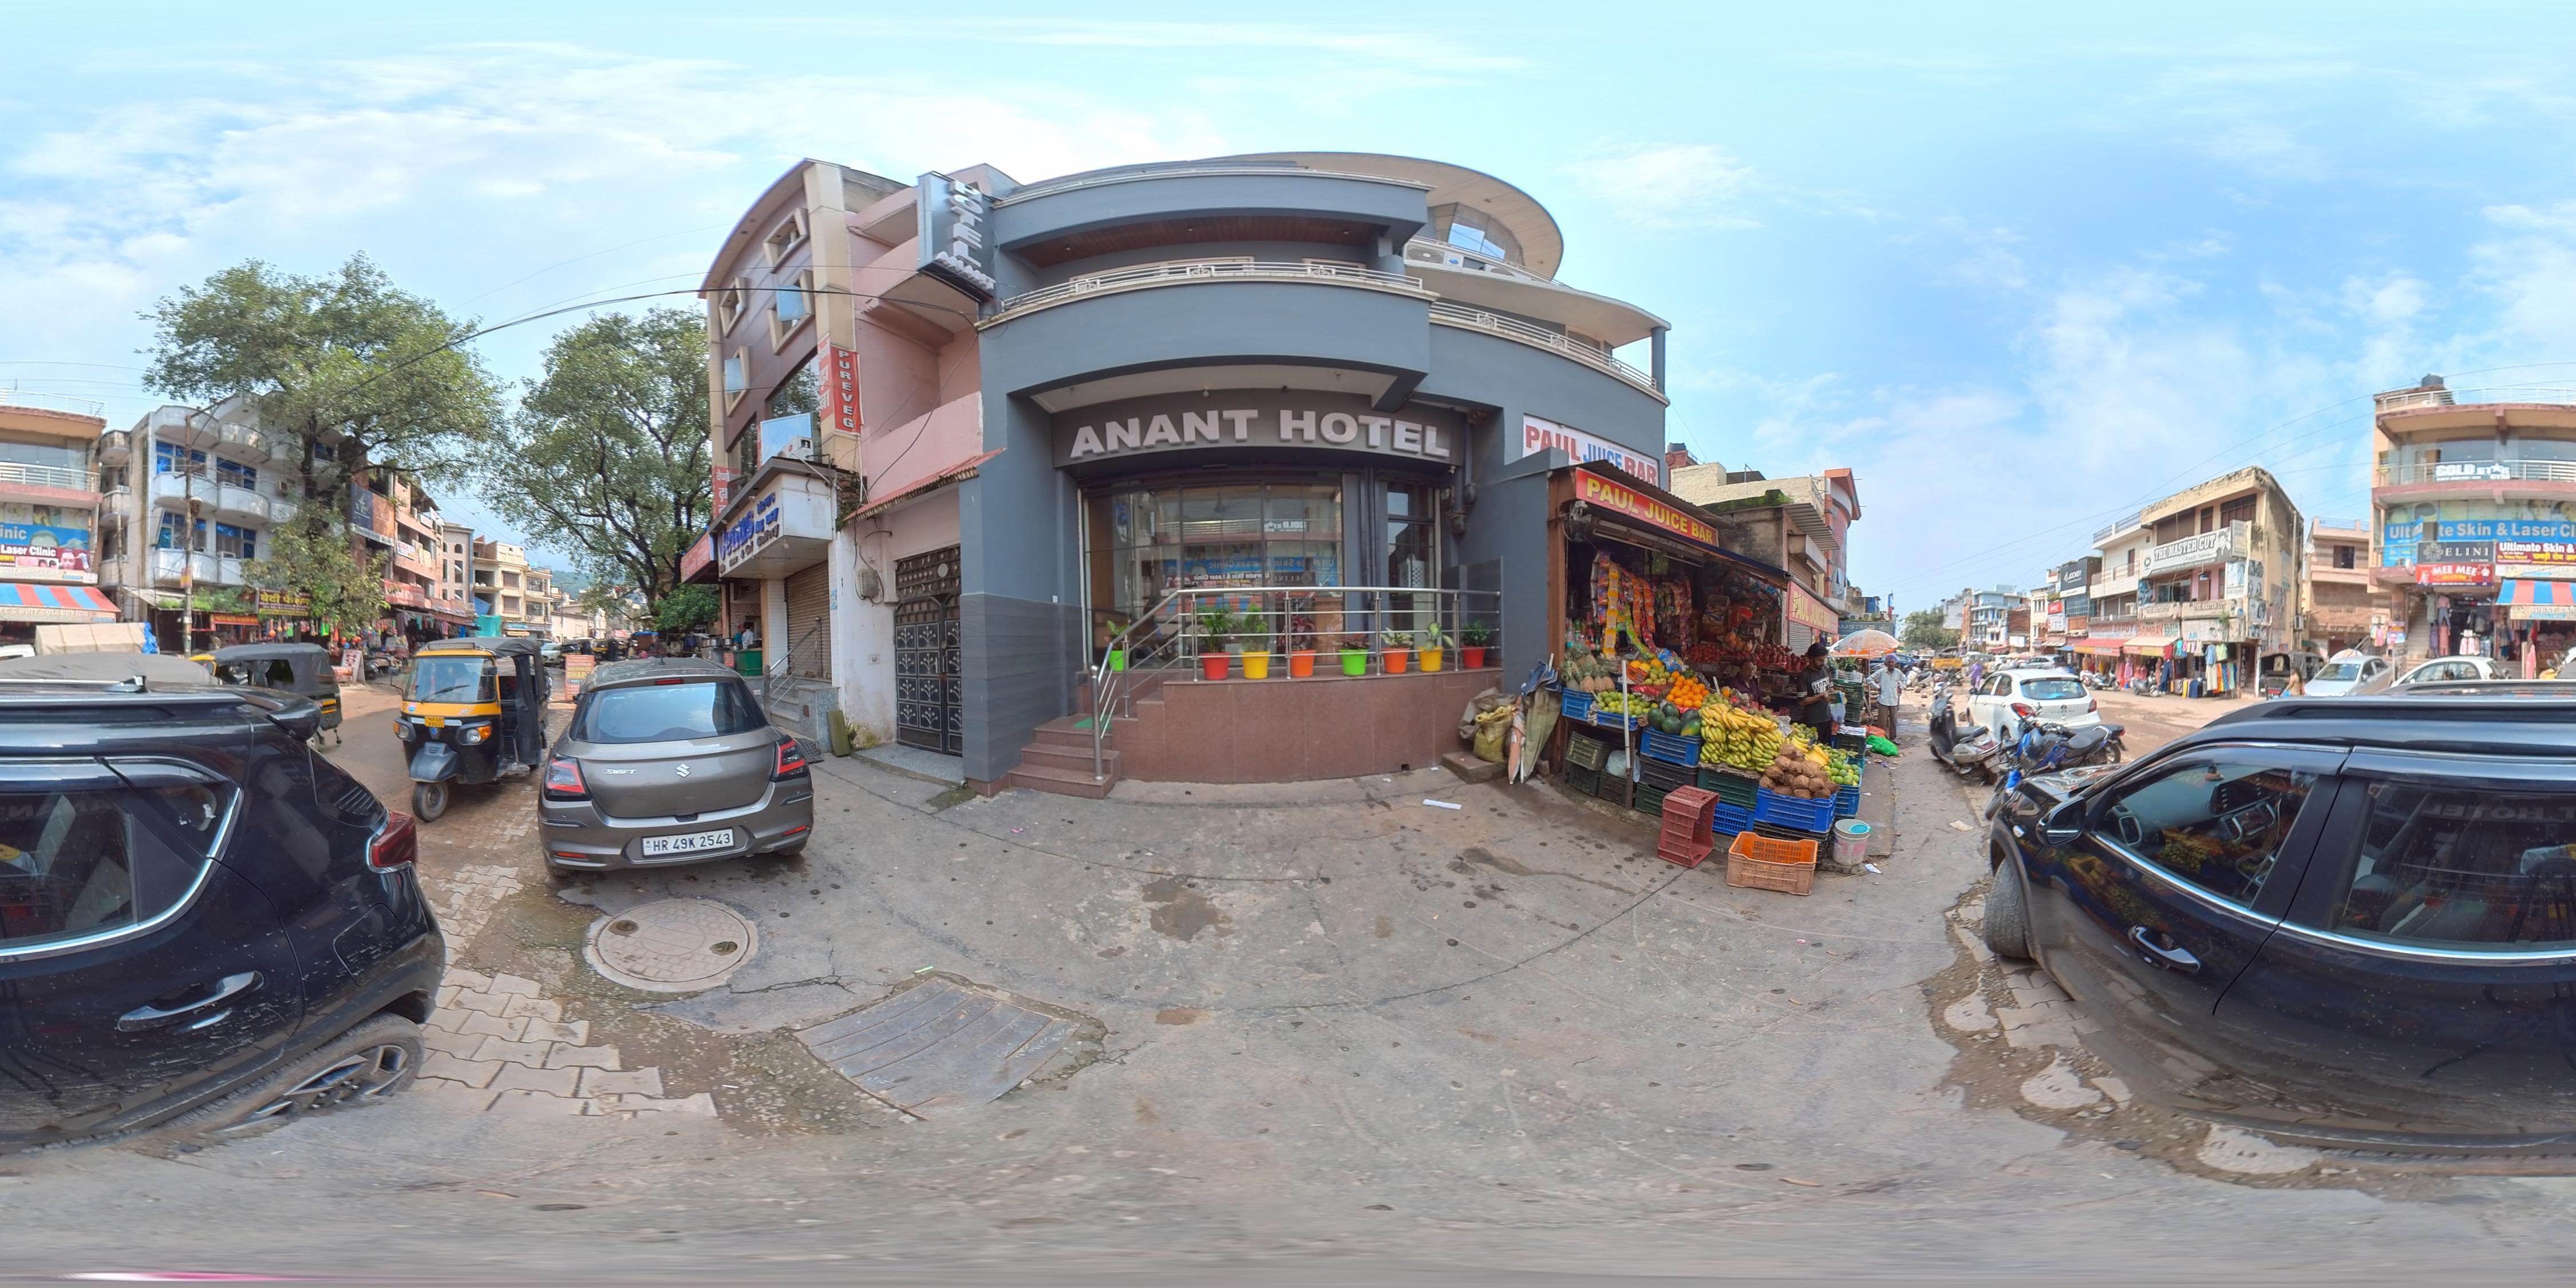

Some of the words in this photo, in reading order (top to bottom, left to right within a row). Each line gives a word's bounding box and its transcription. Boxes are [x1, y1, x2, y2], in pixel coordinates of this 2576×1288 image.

[1070, 409, 1259, 458] ANANT
[1279, 409, 1450, 458] HOTEL
[1526, 424, 1581, 462] PAUL
[1583, 442, 1622, 470] JUICE
[1624, 456, 1658, 486] BAR
[2435, 463, 2476, 476] GOLD
[1586, 477, 1639, 514] PAUL
[1644, 503, 1688, 534] JUICE
[1691, 521, 1713, 544] BAR
[2457, 523, 2491, 536] Skin
[2496, 523, 2507, 536] &
[2512, 522, 2557, 537] Laser
[1, 544, 27, 555] Laser
[29, 546, 57, 558] Clinic
[2155, 547, 2169, 561] THE
[2168, 538, 2198, 558] MASTER
[2198, 533, 2217, 548] CUT
[2445, 547, 2489, 557] ELINI
[2499, 542, 2541, 552] Ultimate
[2543, 542, 2566, 552] Skin
[2432, 565, 2453, 575] MEE
[2456, 564, 2478, 576] MEE
[653, 840, 669, 852] HR
[673, 837, 696, 849] 49K
[699, 833, 730, 848] 2543
